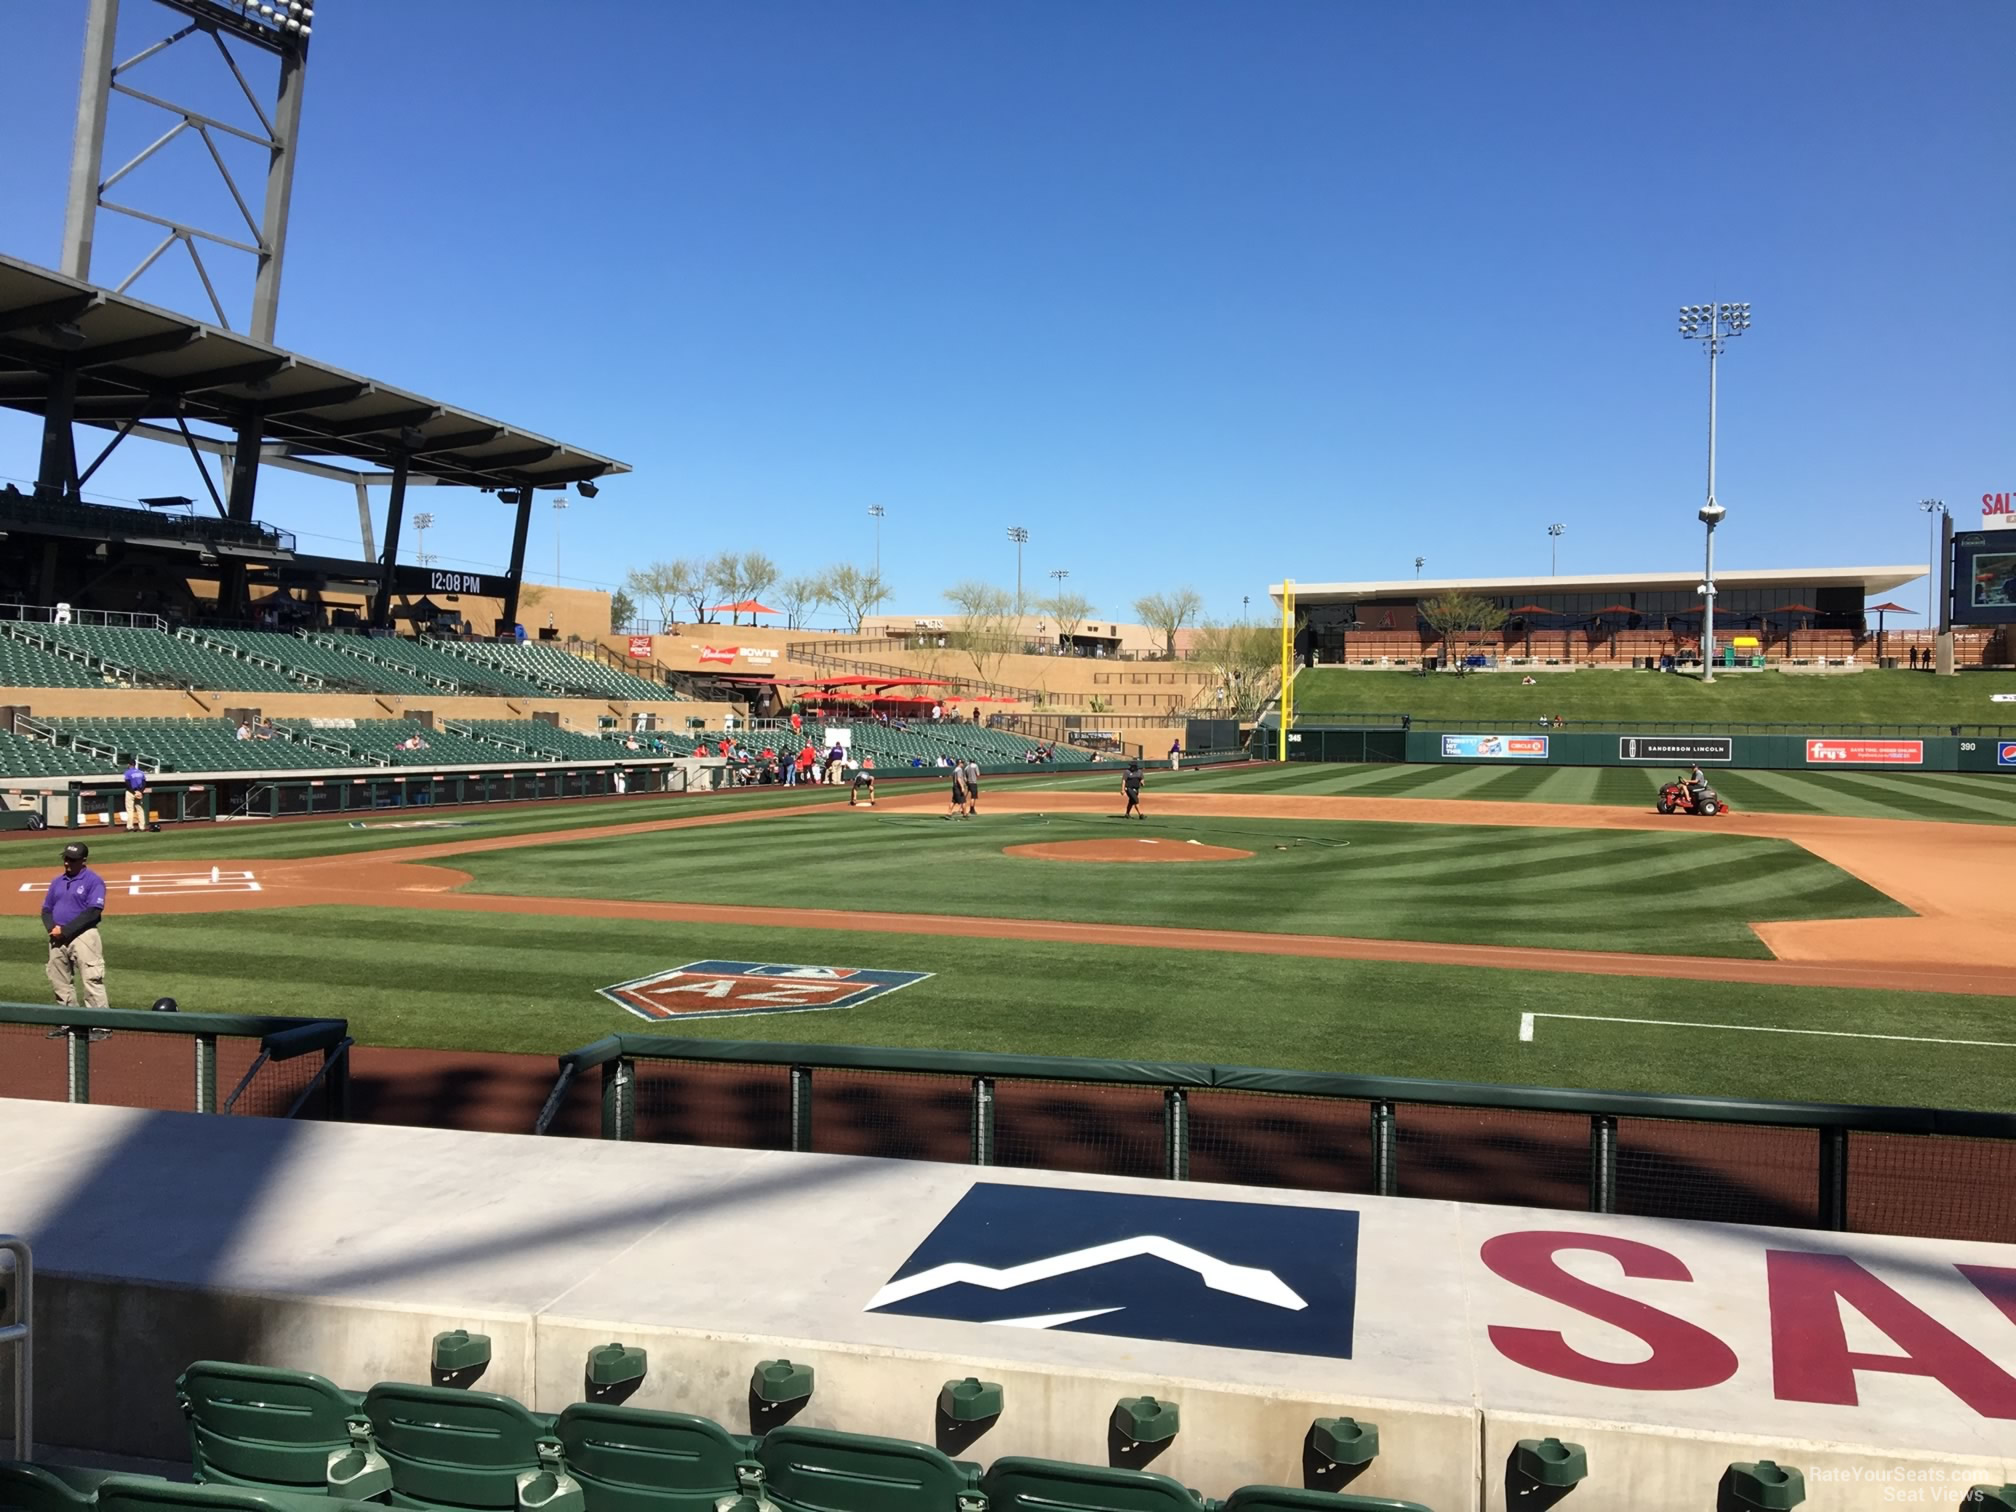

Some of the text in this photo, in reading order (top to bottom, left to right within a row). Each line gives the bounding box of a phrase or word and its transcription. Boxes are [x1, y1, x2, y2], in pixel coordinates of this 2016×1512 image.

[1982, 492, 2016, 515] SAL
[431, 571, 481, 594] 12:08 PM
[703, 647, 779, 659] Budweiser BOWTIE
[1288, 734, 1301, 742] 345
[1960, 742, 1976, 751] 390
[1480, 1230, 2016, 1420] SA
